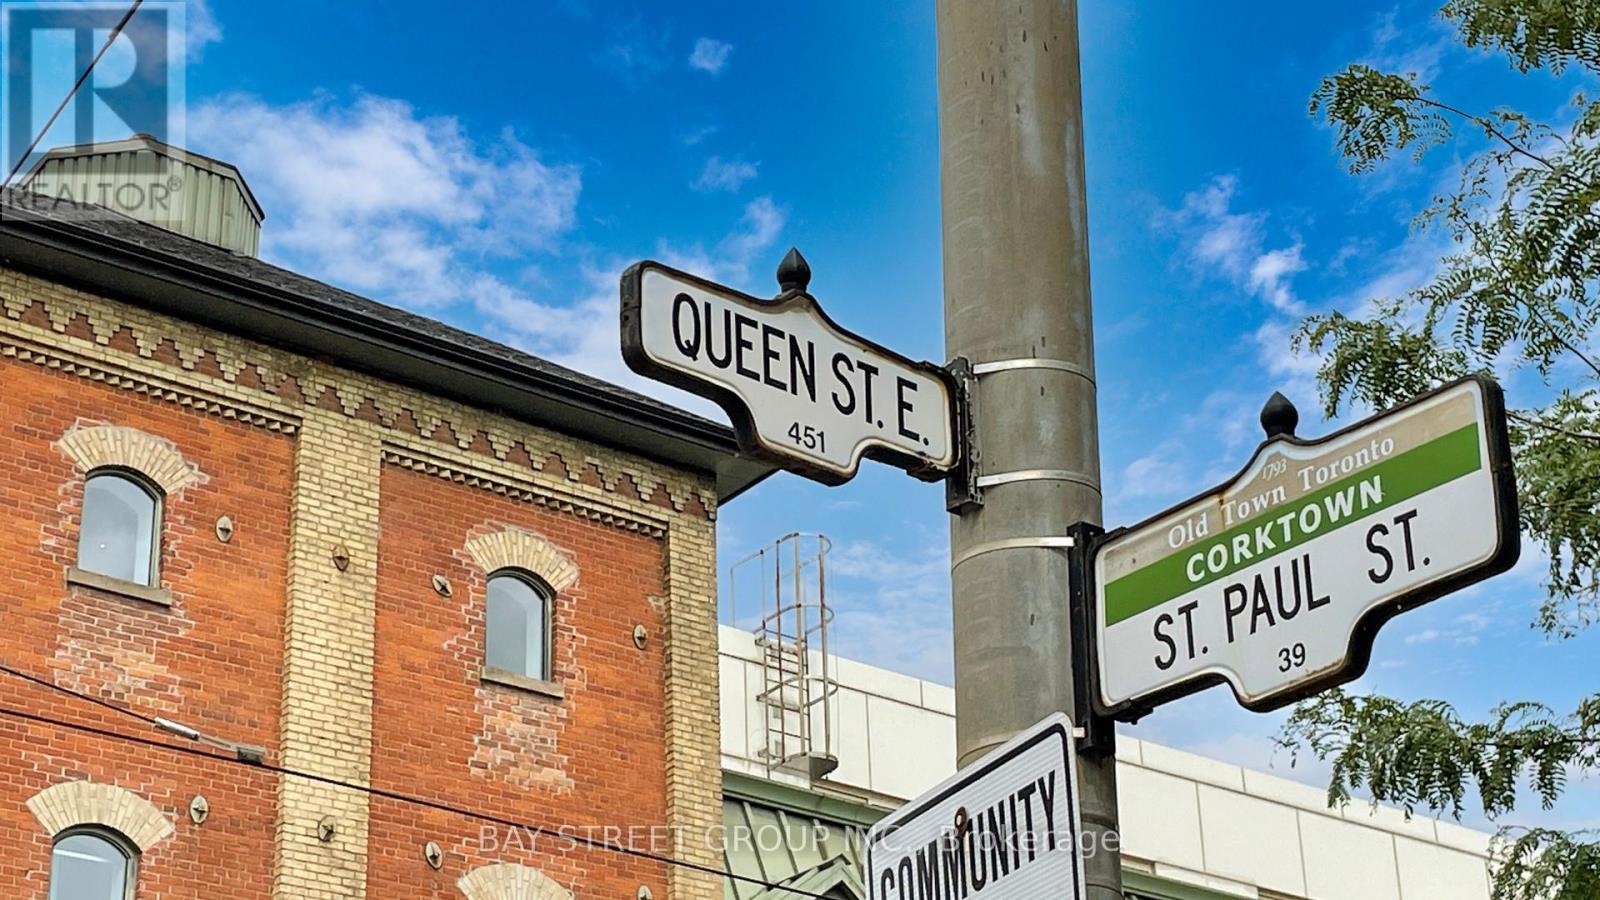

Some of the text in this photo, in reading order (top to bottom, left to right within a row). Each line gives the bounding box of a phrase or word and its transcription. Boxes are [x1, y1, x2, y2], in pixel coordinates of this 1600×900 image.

[672, 292, 930, 446] QUEEN ST. E.
[787, 422, 826, 453] 451
[1262, 458, 1288, 480] 1793
[1168, 437, 1395, 549] Old Town Toronto
[1185, 474, 1384, 583] CORKTOWN
[1153, 508, 1431, 671] ST. PAUL ST.
[1277, 642, 1307, 673] 39
